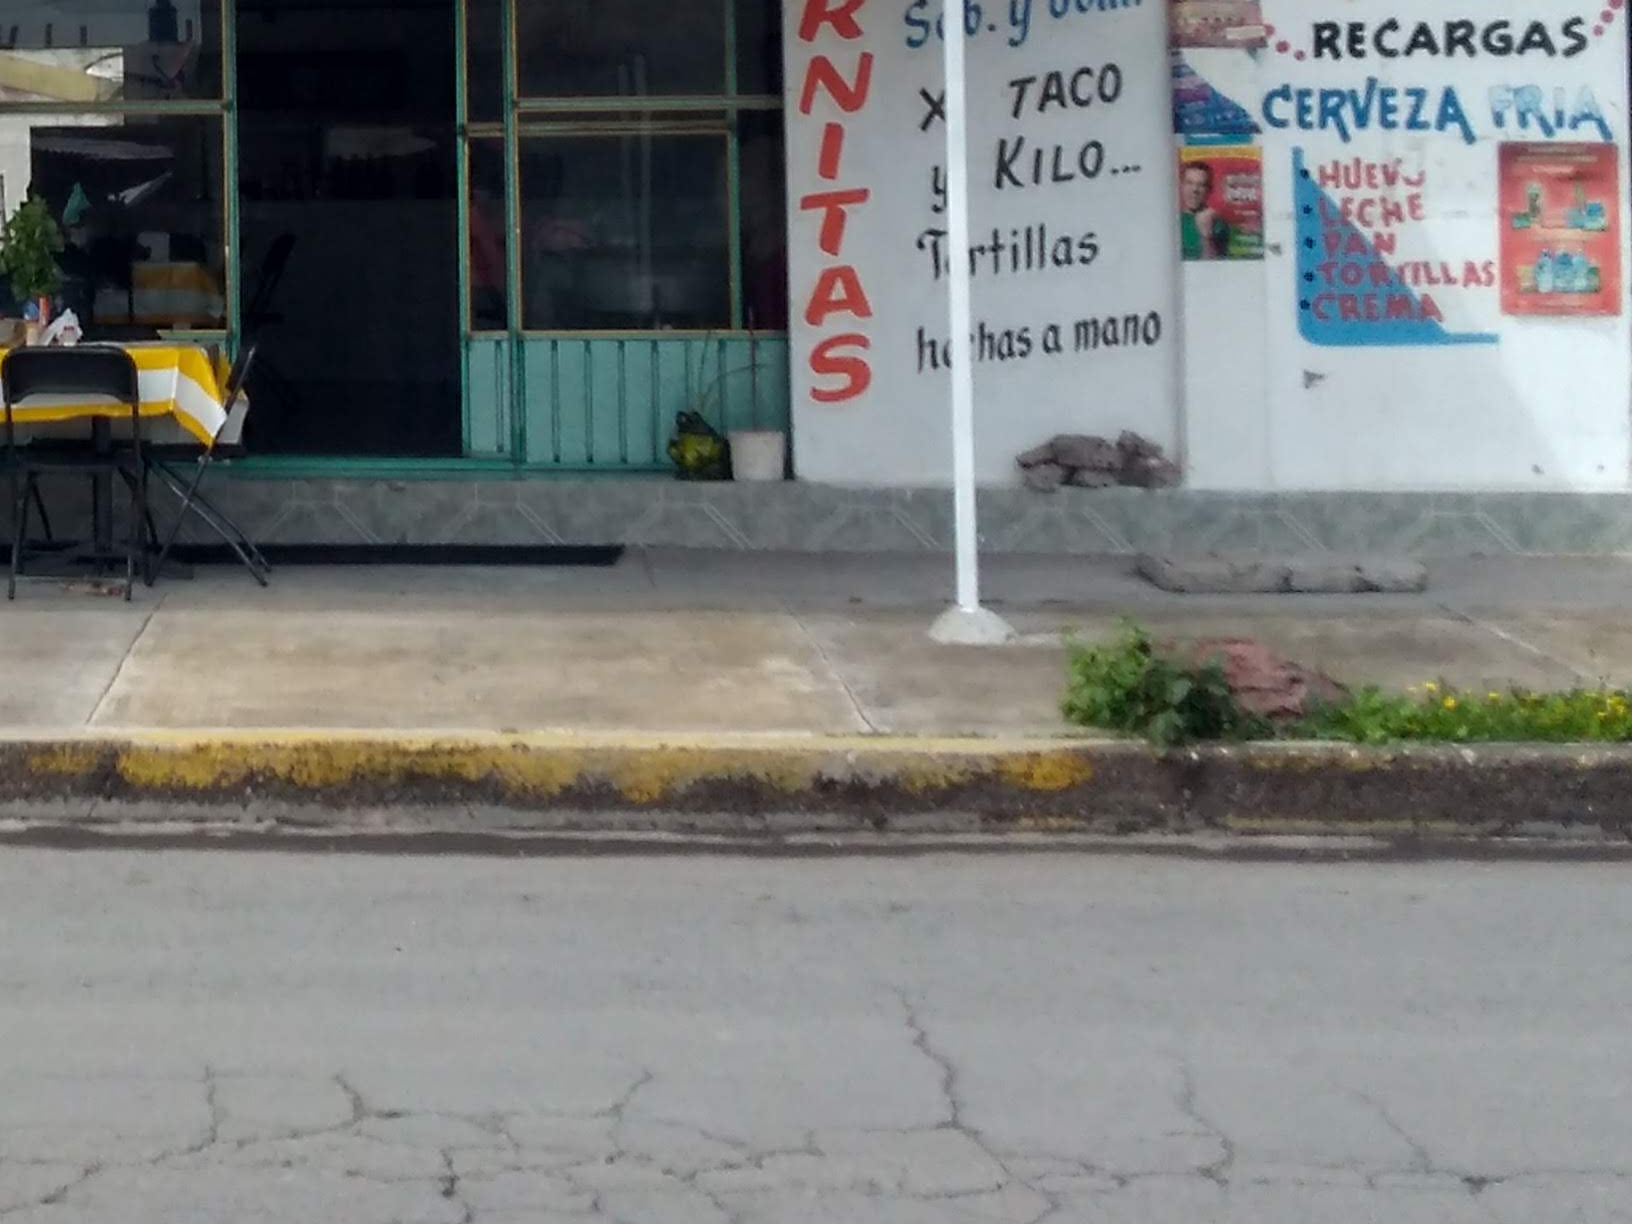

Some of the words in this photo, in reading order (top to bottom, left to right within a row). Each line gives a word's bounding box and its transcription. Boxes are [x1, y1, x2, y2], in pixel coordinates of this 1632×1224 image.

[1312, 17, 1588, 60] RECARGAS
[1009, 63, 1122, 110] TACO
[1262, 76, 1477, 145] CERVEZA
[1488, 84, 1614, 142] FRIA
[1319, 192, 1425, 228] LECHE
[916, 223, 1099, 279] Trtillas
[1323, 232, 1396, 255] PAN
[1316, 260, 1496, 288] TORTILLAS
[1311, 293, 1445, 322] CREMA
[1042, 323, 1063, 354] a
[1075, 310, 1162, 352] mano
